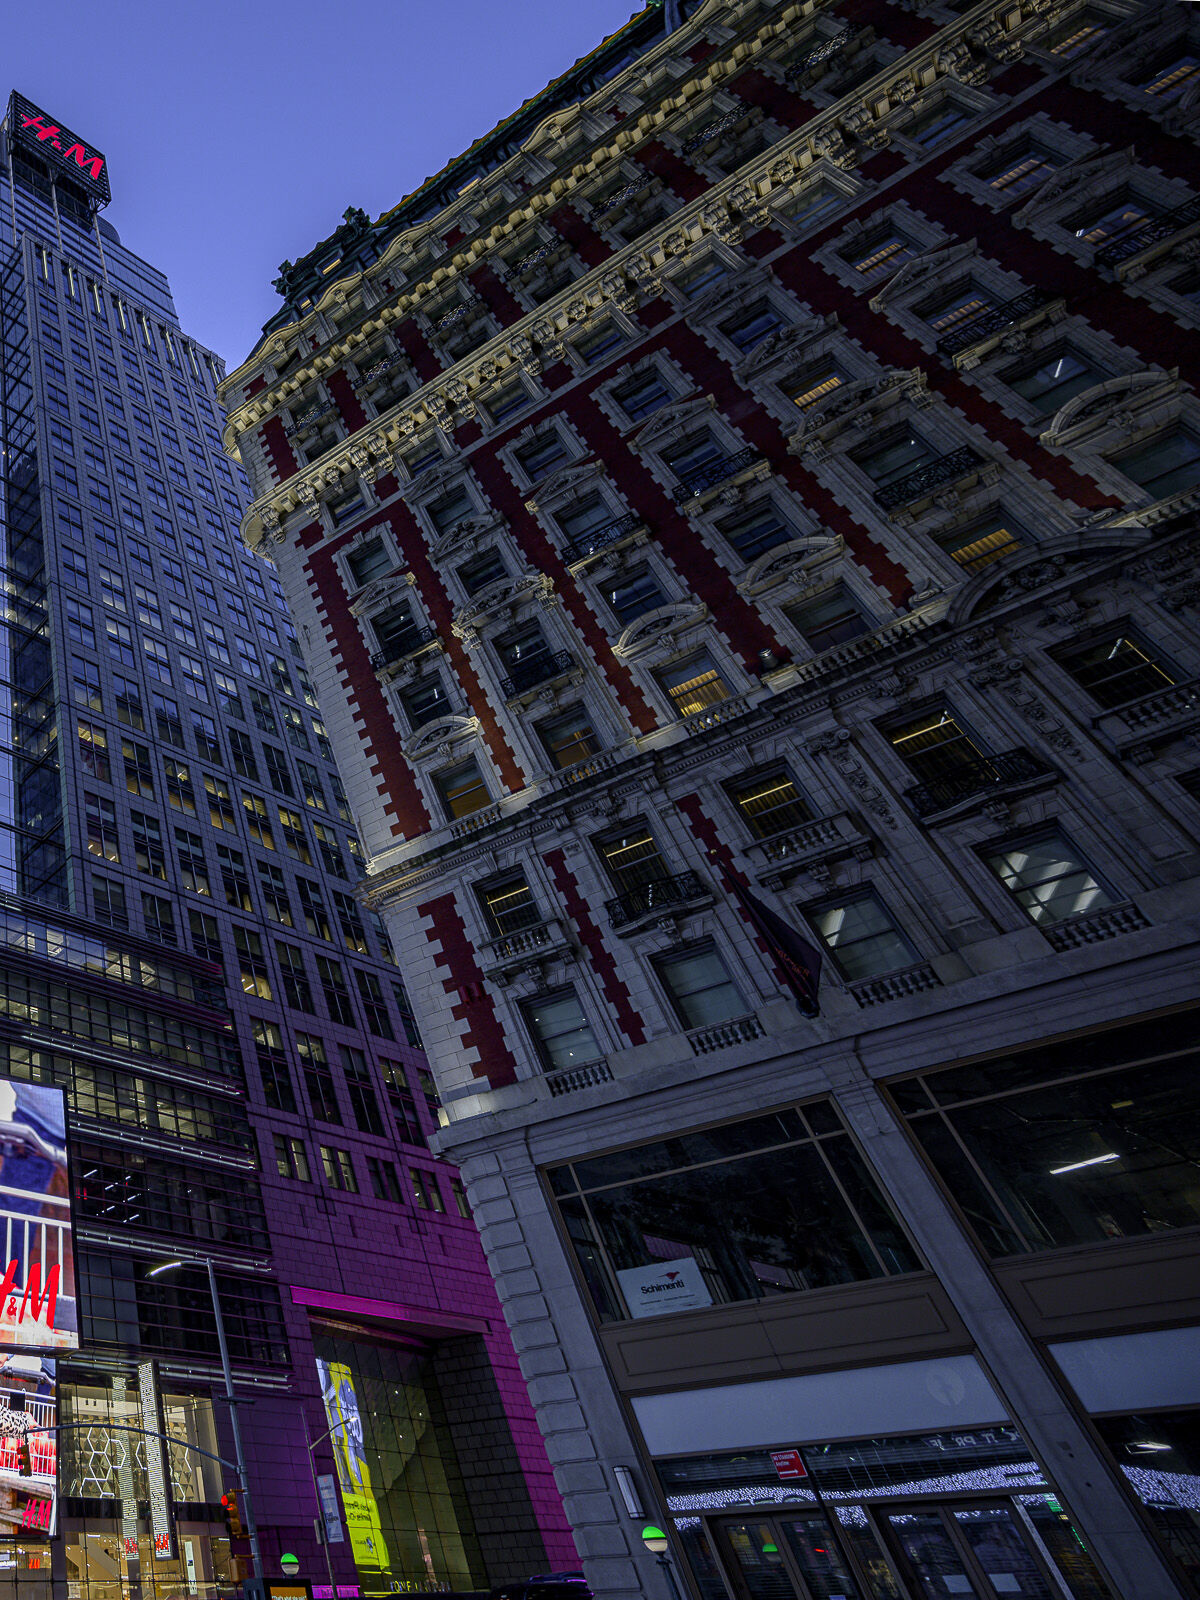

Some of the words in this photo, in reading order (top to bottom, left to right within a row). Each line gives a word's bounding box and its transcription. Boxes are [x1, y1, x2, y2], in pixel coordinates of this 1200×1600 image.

[20, 113, 104, 180] H&M
[641, 1279, 685, 1294] Schimenti
[21, 1499, 52, 1528] H&M
